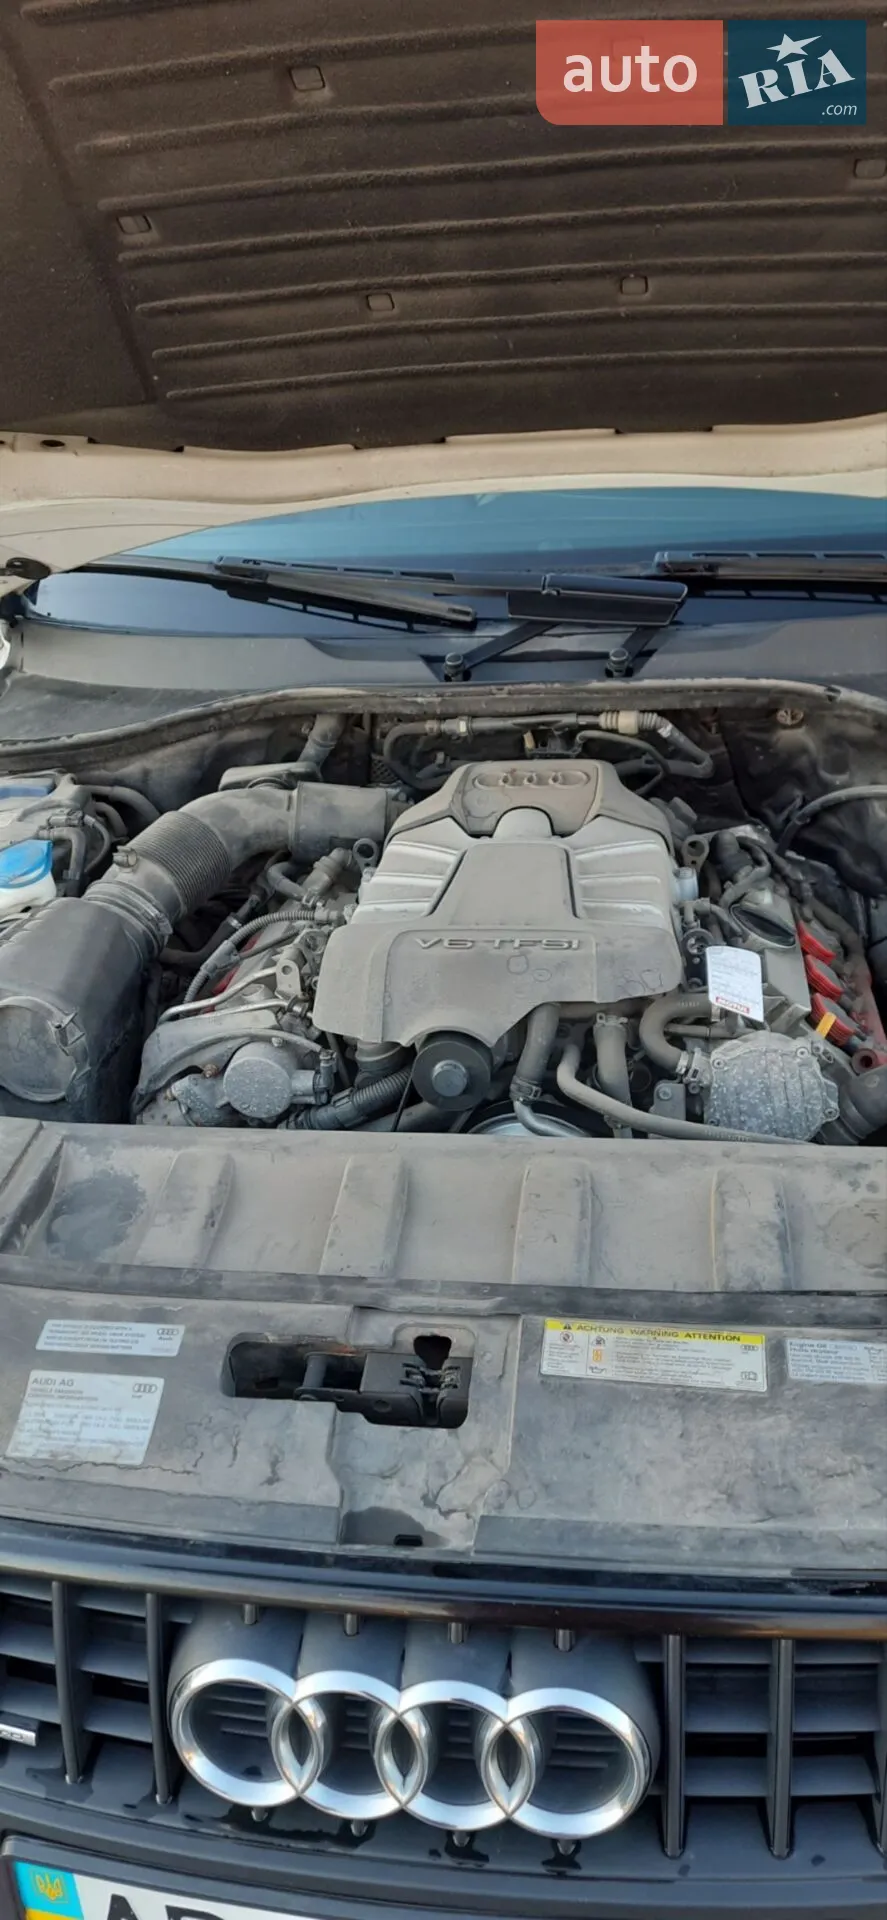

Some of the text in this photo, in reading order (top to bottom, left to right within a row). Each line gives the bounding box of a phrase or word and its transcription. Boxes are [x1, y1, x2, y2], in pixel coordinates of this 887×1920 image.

[415, 937, 581, 950] V6 TFSI
[576, 1324, 624, 1334] ACHTUNG
[630, 1328, 680, 1338] WARNING
[685, 1332, 741, 1342] ATTENTION
[32, 1378, 75, 1387] AUDI AG
